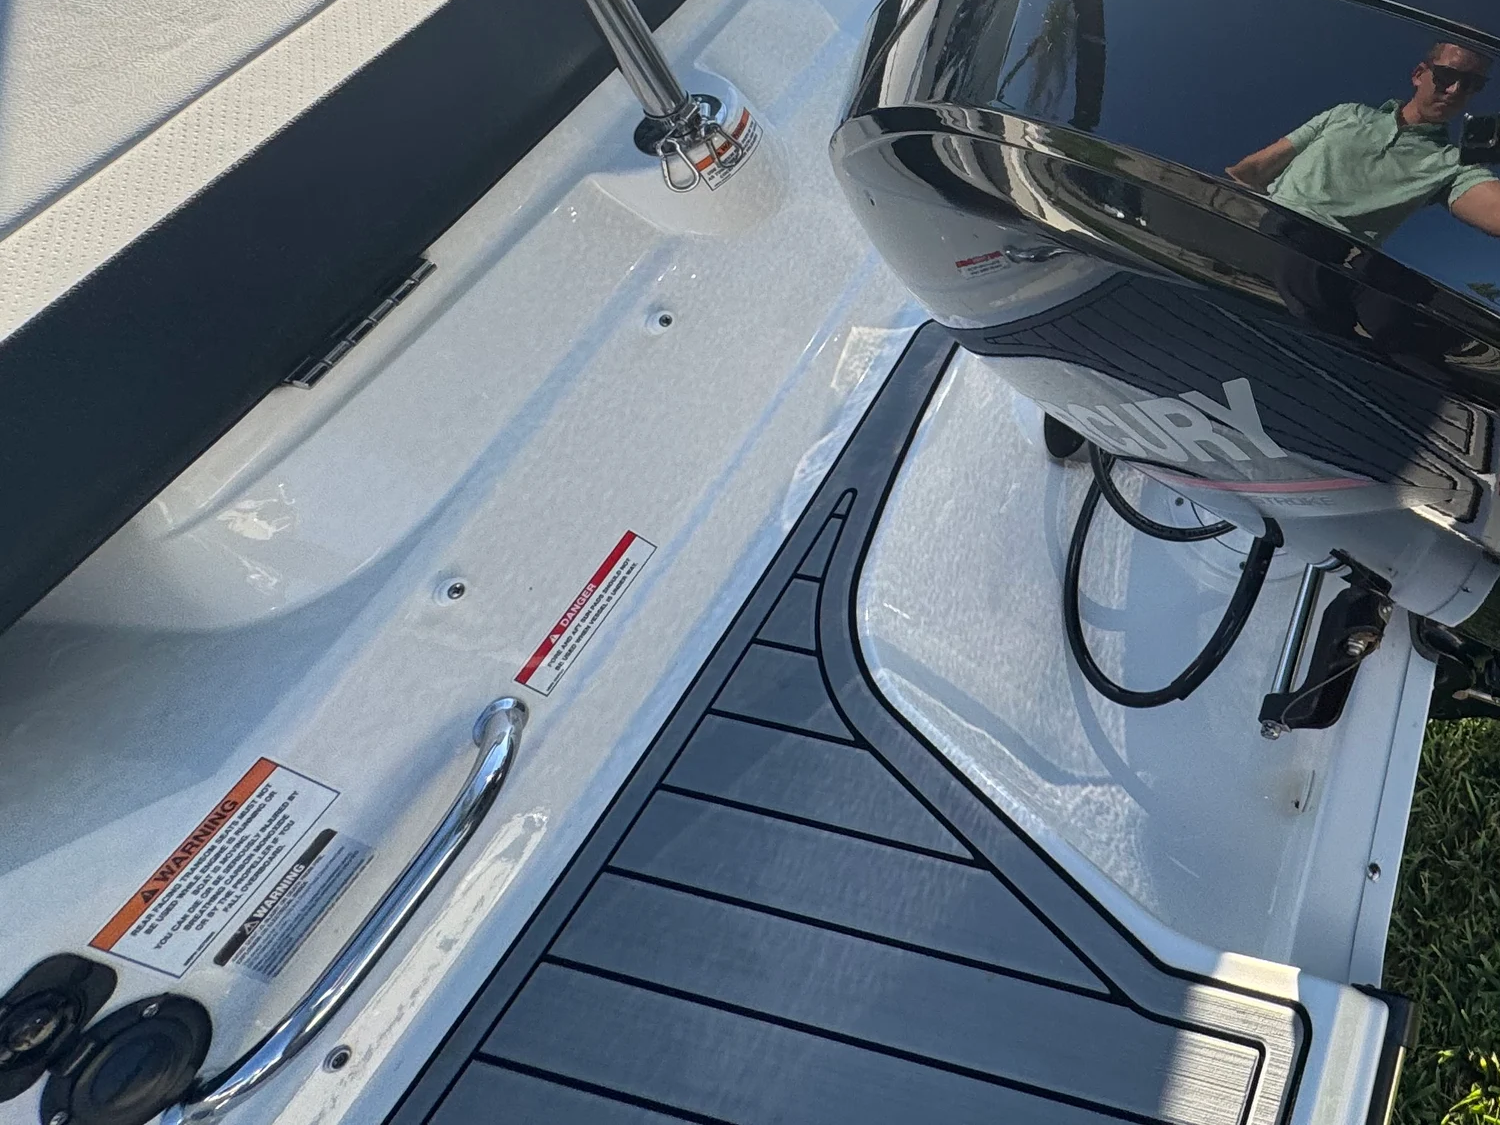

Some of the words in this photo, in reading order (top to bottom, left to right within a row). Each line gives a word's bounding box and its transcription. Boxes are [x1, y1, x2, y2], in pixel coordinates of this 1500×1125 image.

[558, 581, 598, 628] DANGER
[561, 643, 577, 661] USED
[574, 624, 592, 644] WHEN
[588, 601, 608, 625] VESSEL
[610, 574, 628, 596] UNDER
[601, 569, 622, 594] SHOULD
[129, 912, 156, 937] REAR
[151, 882, 183, 913] FACING
[178, 844, 218, 883] TRANSOM
[213, 819, 240, 844] SEATS
[235, 798, 259, 820] MUST
[254, 782, 273, 799] NOT
[152, 797, 240, 885] WARNING
[153, 931, 174, 950] YOU
[169, 912, 191, 932] CAN
[185, 898, 203, 914] DIE
[198, 885, 215, 899] OR
[220, 832, 262, 875] SERIOUSLY
[257, 800, 290, 833] INJURED
[154, 899, 180, 922] USED
[175, 873, 203, 900] WHILE
[198, 844, 229, 874] ENGINE
[232, 801, 268, 836] RUNNING
[262, 790, 278, 803] OR
[182, 885, 227, 931] BREATHING
[222, 852, 256, 886] CARBON
[251, 813, 290, 853] MONOXIDE
[190, 872, 215, 896] BOAT
[193, 917, 210, 931] OR
[216, 888, 235, 905] THE
[230, 843, 274, 890] PROPELLER
[276, 819, 296, 836] YOU
[221, 891, 244, 913] FALL
[252, 861, 306, 920] WARNING
